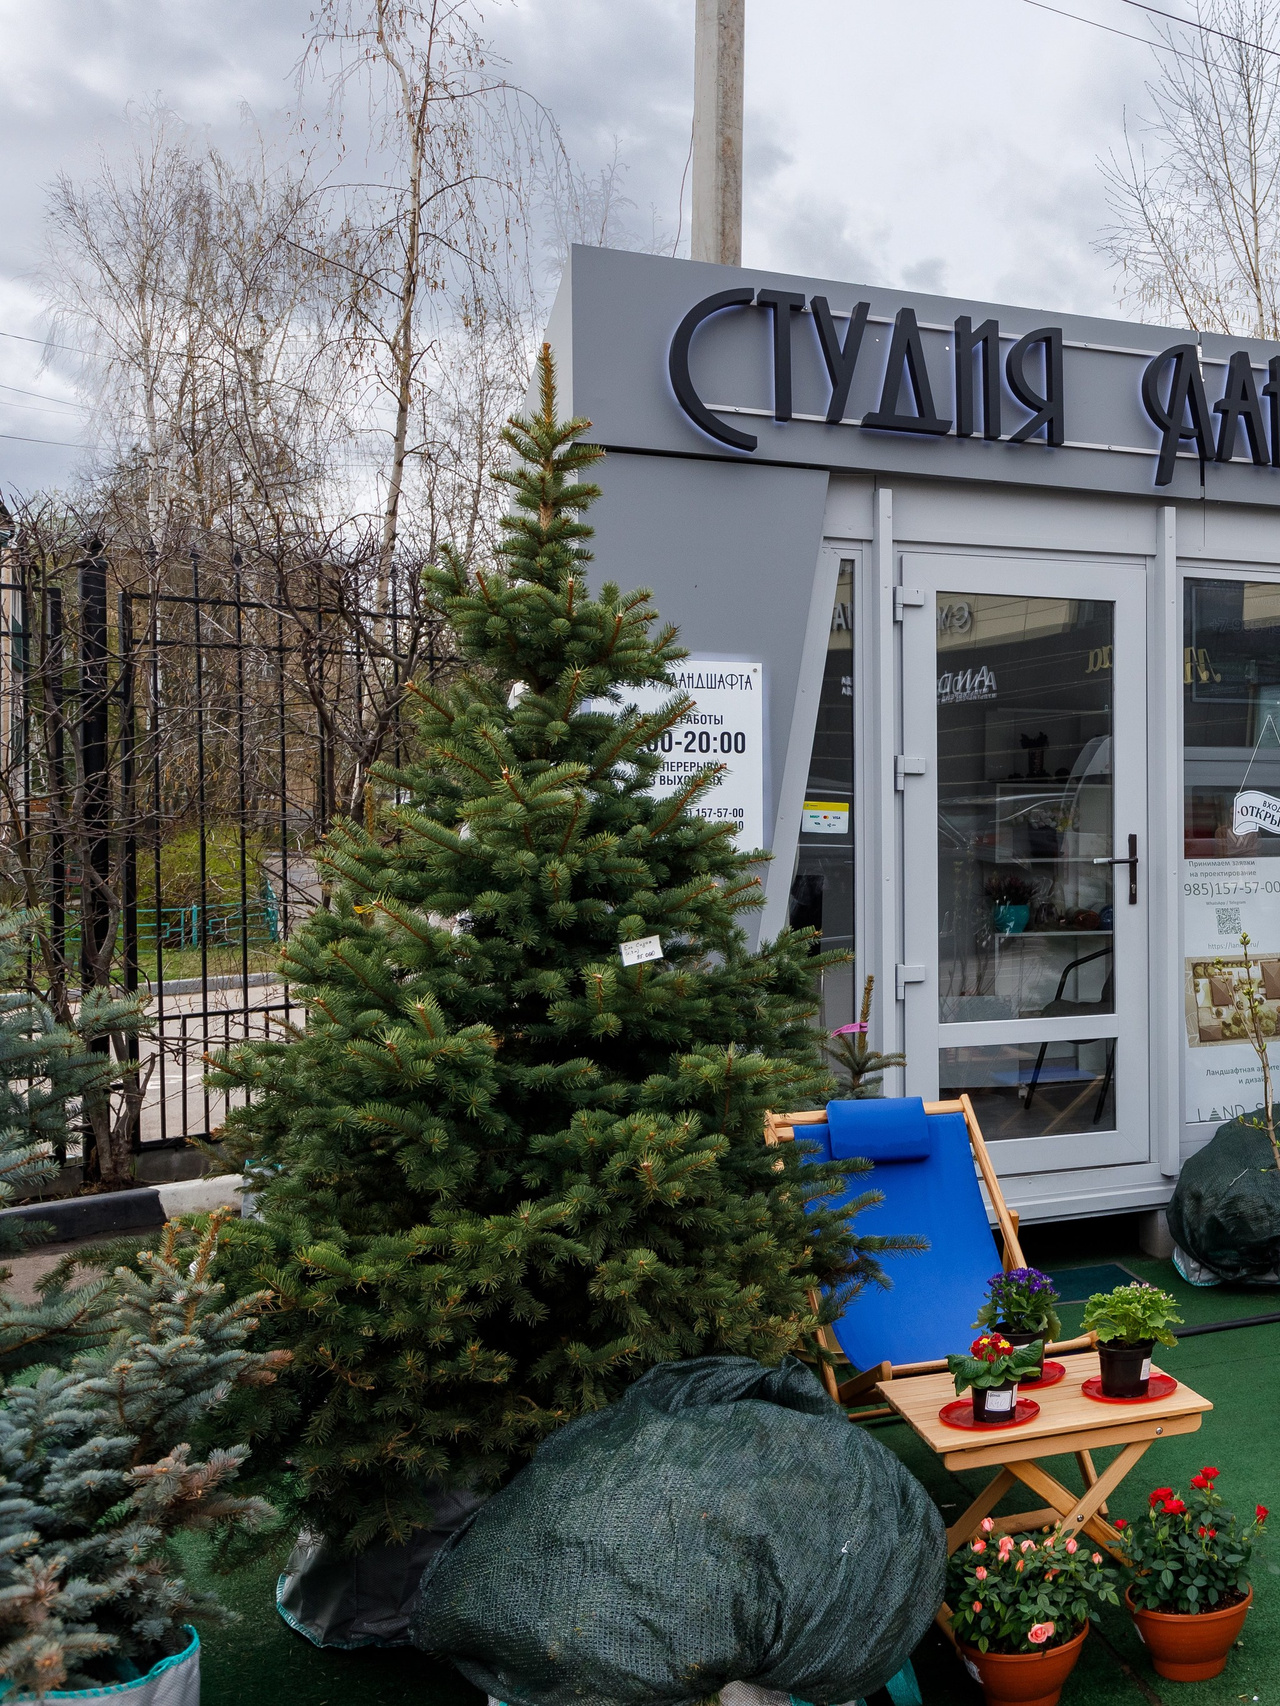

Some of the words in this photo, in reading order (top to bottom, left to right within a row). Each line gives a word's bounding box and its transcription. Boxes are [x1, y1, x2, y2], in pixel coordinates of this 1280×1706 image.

[668, 287, 1065, 452] СТУДИЯ
[1188, 860, 1231, 868] Принимаем
[1200, 870, 1257, 878] проектирование
[1205, 1067, 1255, 1077] Ландшафтная
